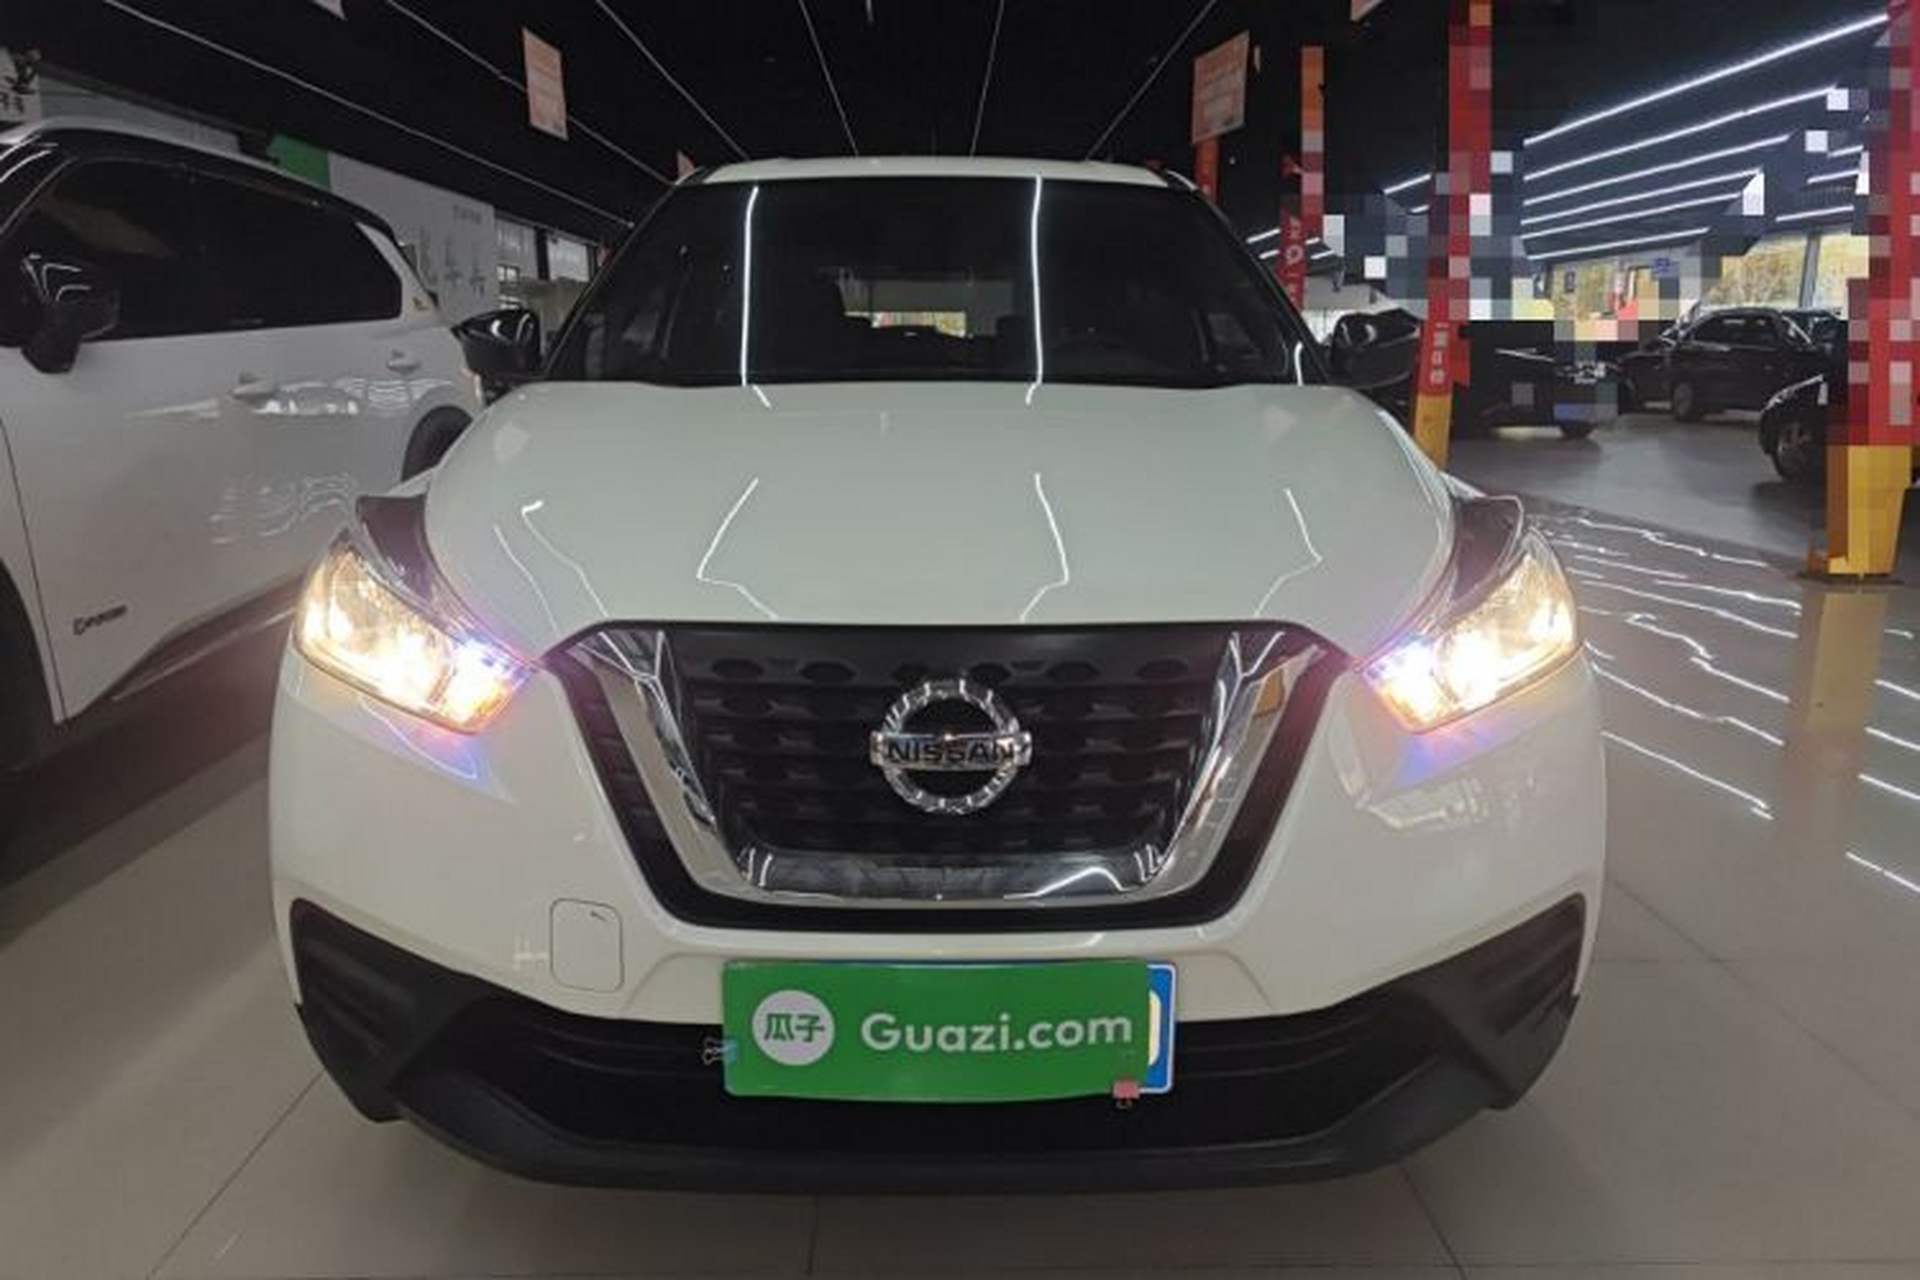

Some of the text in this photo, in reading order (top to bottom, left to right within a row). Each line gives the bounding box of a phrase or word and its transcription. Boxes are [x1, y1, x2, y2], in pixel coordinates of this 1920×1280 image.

[888, 738, 1015, 764] NISSAN
[763, 1013, 825, 1043] 瓜子
[861, 1012, 1132, 1052] Guazi.com
